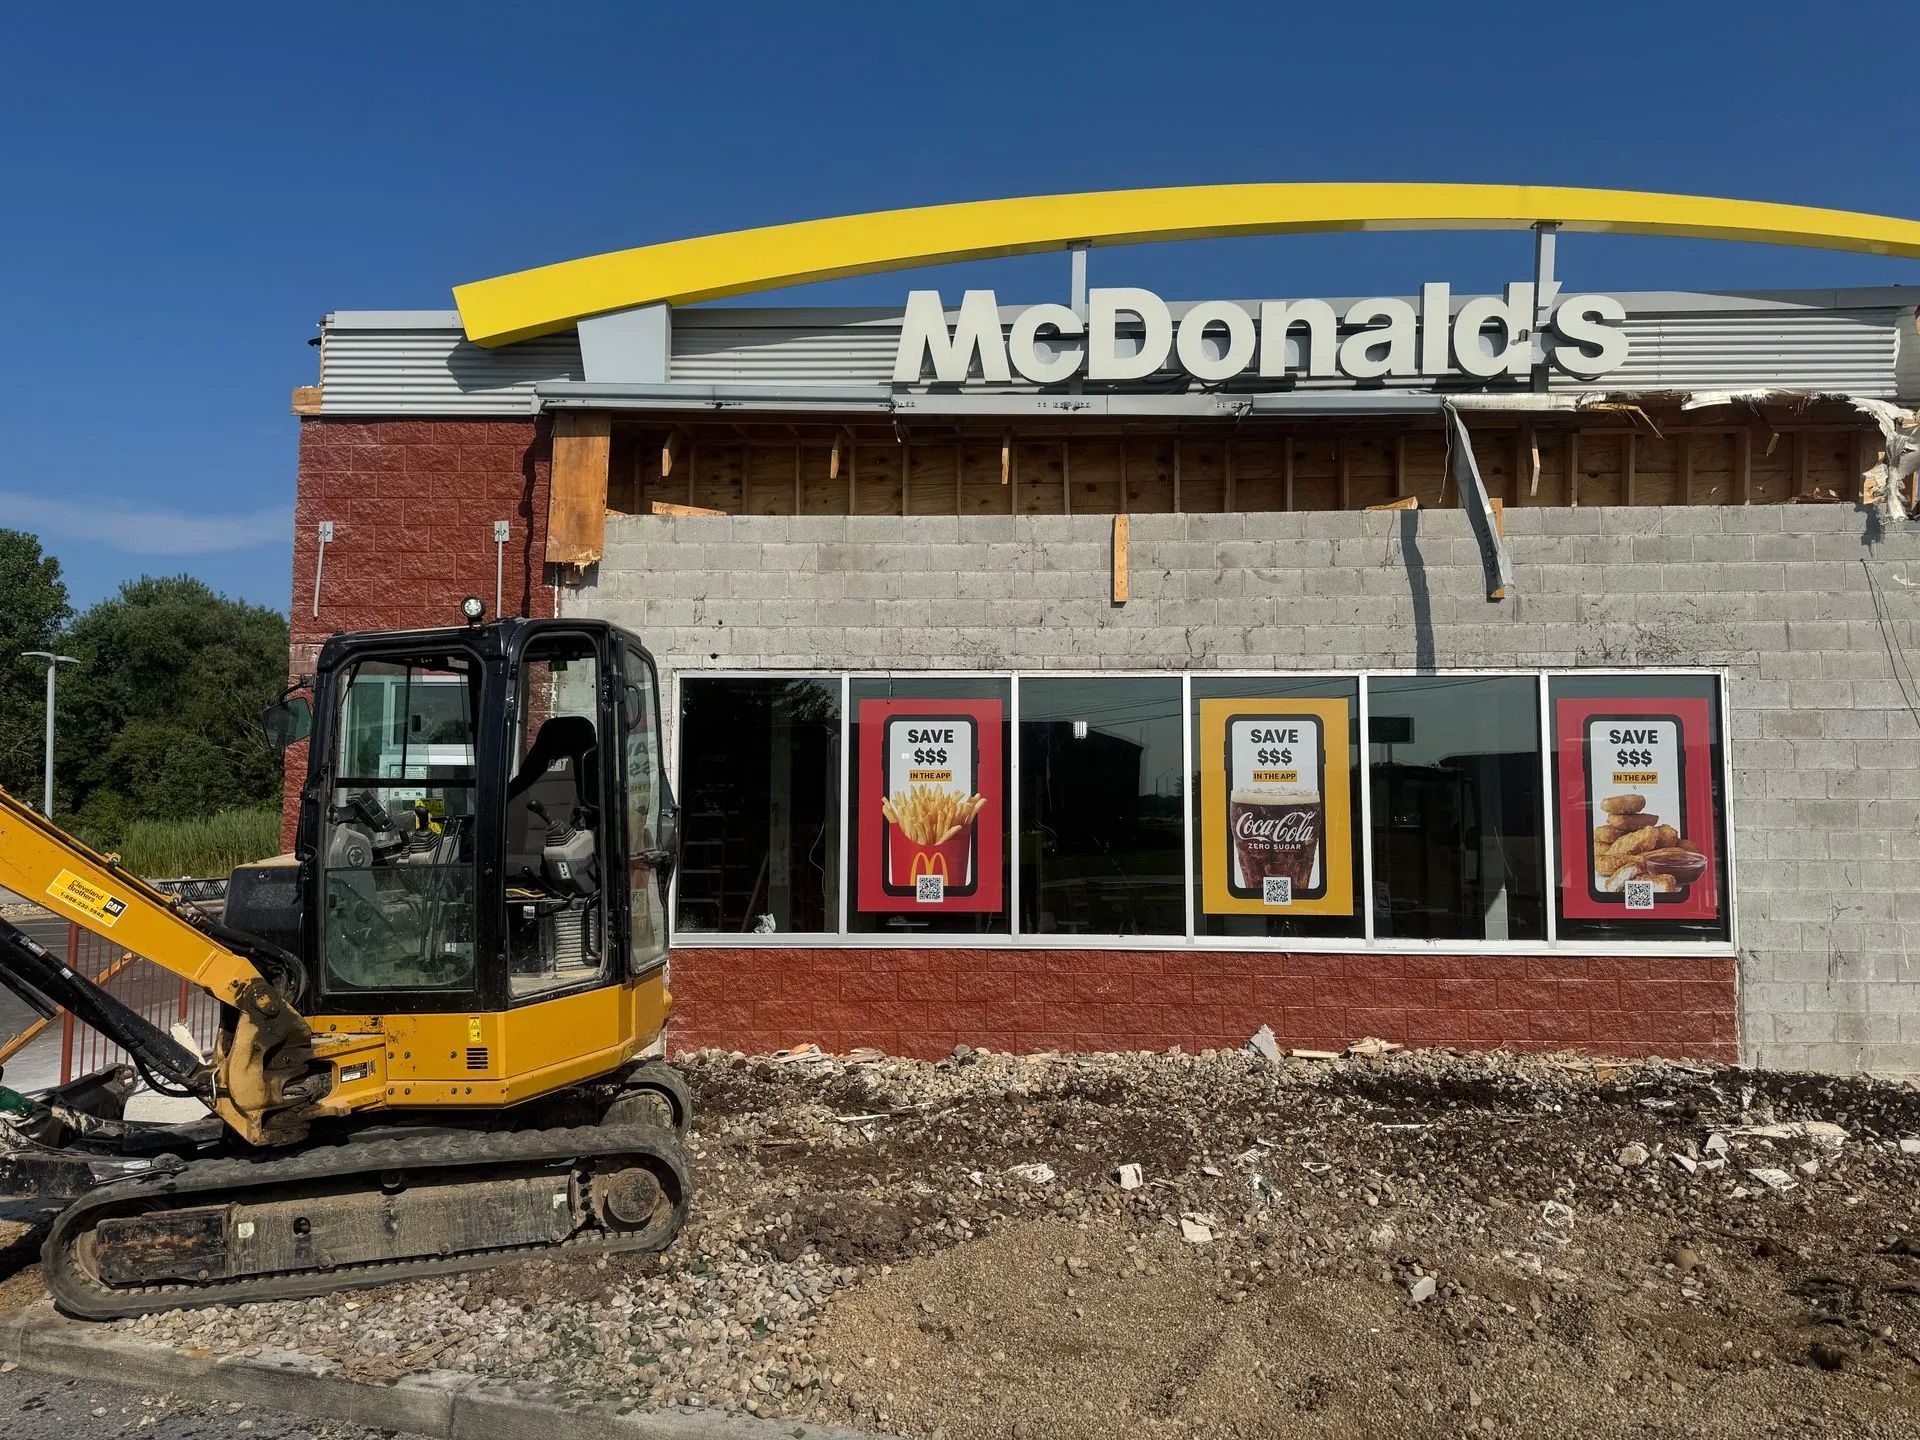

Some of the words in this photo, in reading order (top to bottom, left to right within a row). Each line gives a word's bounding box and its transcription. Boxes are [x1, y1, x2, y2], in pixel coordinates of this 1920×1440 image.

[892, 281, 1630, 384] McDonald's
[908, 729, 954, 743] SAVE
[1251, 729, 1298, 743] SAVE
[1609, 729, 1658, 744] SAVE
[547, 758, 569, 772] CAT
[914, 748, 948, 765] $$$
[1257, 748, 1292, 766] $$$
[1617, 748, 1652, 767] $$$
[1236, 811, 1317, 842] Coca-Cola
[68, 884, 95, 903] Brothers
[72, 879, 104, 900] Cleveland
[105, 900, 122, 914] CAT
